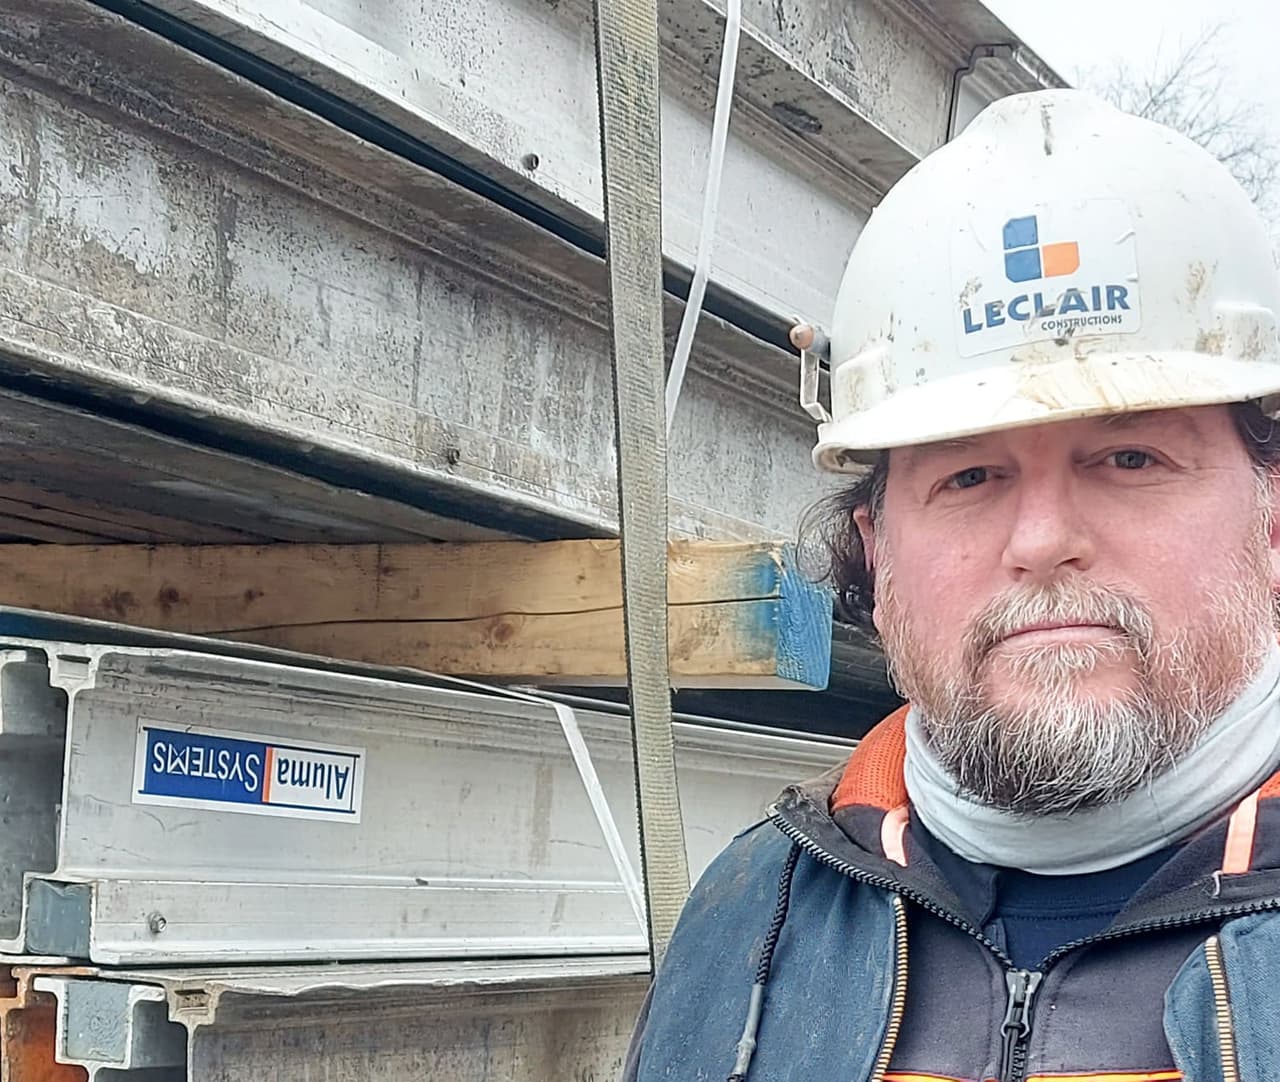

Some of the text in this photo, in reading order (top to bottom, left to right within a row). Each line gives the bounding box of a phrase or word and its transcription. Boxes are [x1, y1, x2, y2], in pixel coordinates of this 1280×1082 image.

[963, 285, 1130, 334] LECLAIR
[1041, 315, 1122, 331] CONSTRUCTIONS
[152, 742, 350, 800] Aluma SYSTEMS
